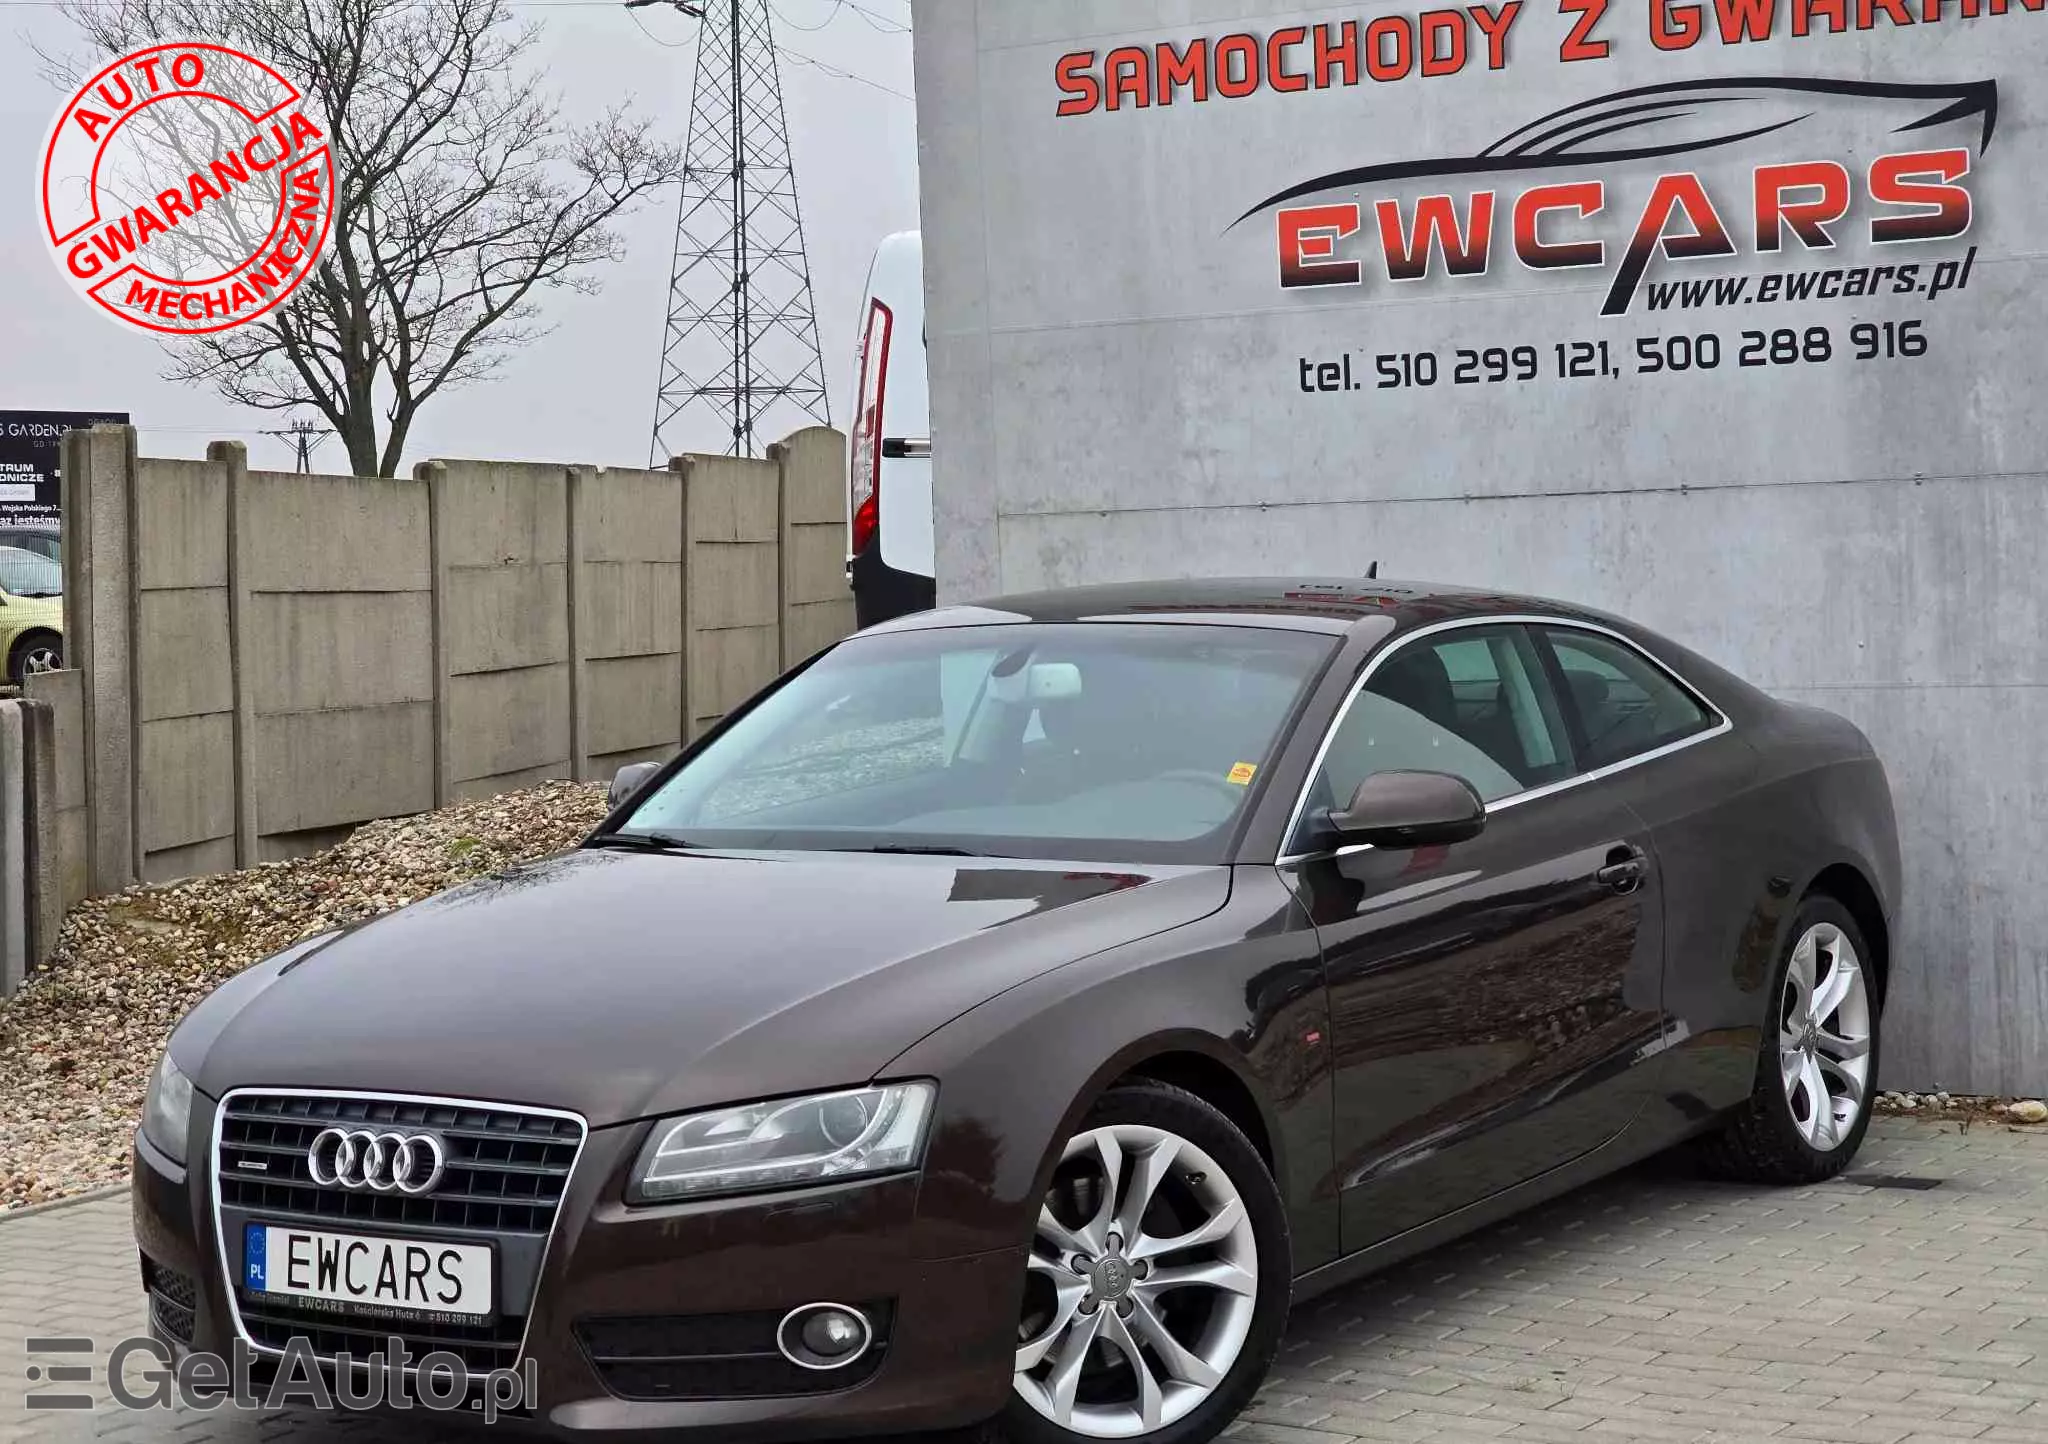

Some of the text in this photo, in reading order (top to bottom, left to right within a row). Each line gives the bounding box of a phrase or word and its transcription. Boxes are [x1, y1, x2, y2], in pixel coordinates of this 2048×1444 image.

[1055, 0, 2046, 117] SAMOCHODY Z GWAR
[1276, 148, 1972, 317] EWCARS
[1648, 246, 1978, 311] www.ewcars.pl
[1299, 319, 1928, 393] tel. 510 299 121, 500 288 916
[250, 1264, 265, 1280] PL
[287, 1234, 462, 1304] EWCARS
[298, 1297, 345, 1313] EWCARS
